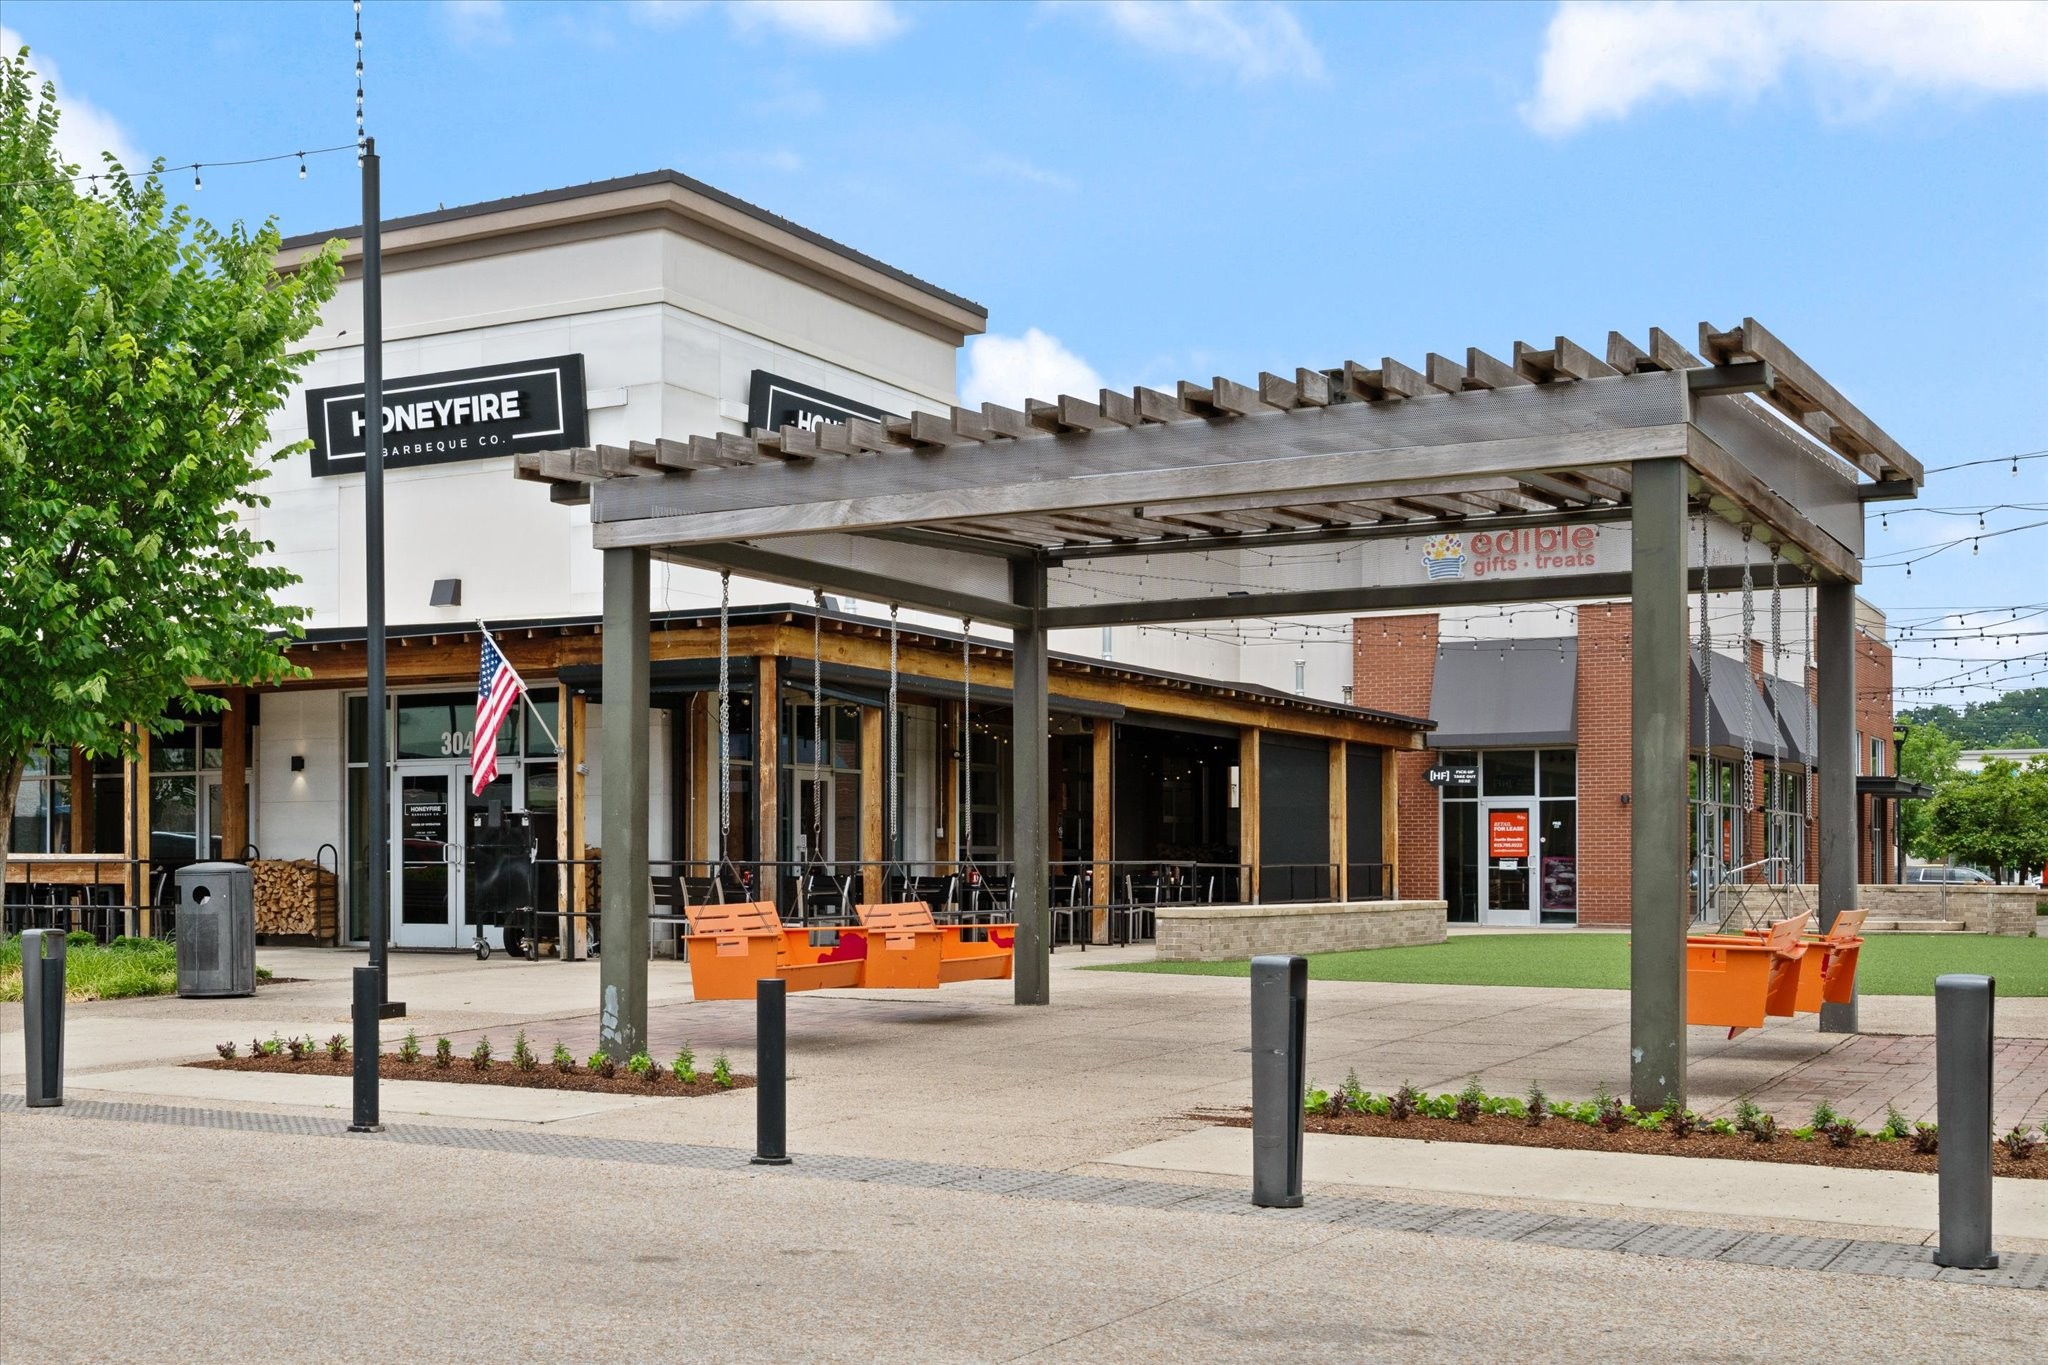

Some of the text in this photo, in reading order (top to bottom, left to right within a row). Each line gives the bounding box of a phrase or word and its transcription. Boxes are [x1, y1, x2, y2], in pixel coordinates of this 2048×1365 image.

[351, 390, 521, 437] HONEYFIRE
[382, 434, 506, 457] BARBEQUE CO.
[1470, 524, 1595, 555] edible
[1473, 552, 1595, 576] gifts treats
[441, 731, 474, 755] 304
